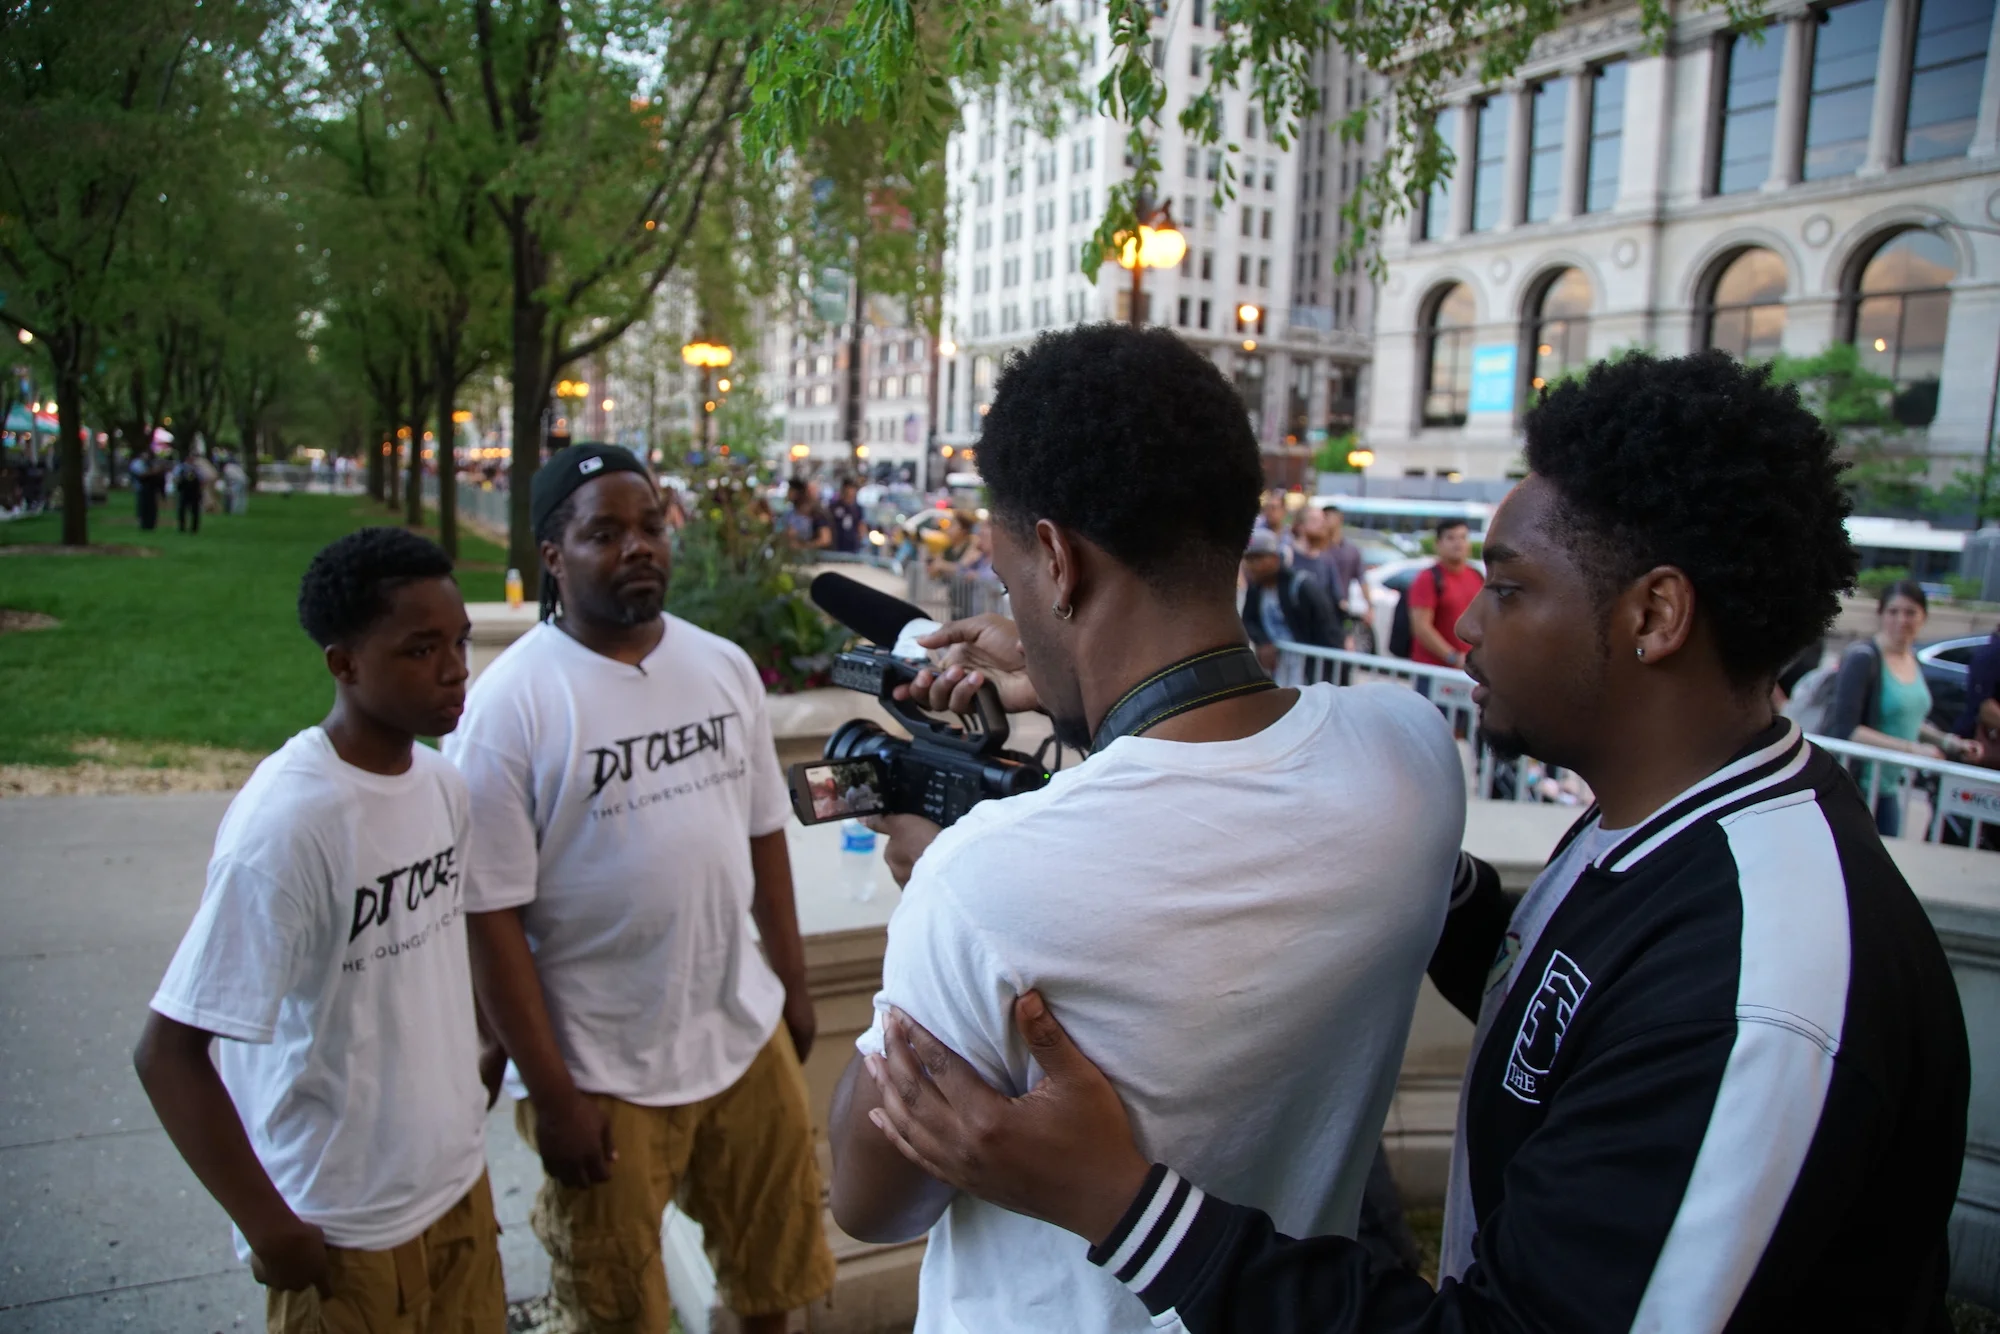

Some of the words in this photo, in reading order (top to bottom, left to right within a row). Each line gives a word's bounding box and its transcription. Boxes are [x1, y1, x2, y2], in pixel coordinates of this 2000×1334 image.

[582, 735, 646, 803] DJ
[592, 804, 622, 820] THE
[349, 866, 409, 944] DJ
[1509, 1062, 1536, 1093] THE
